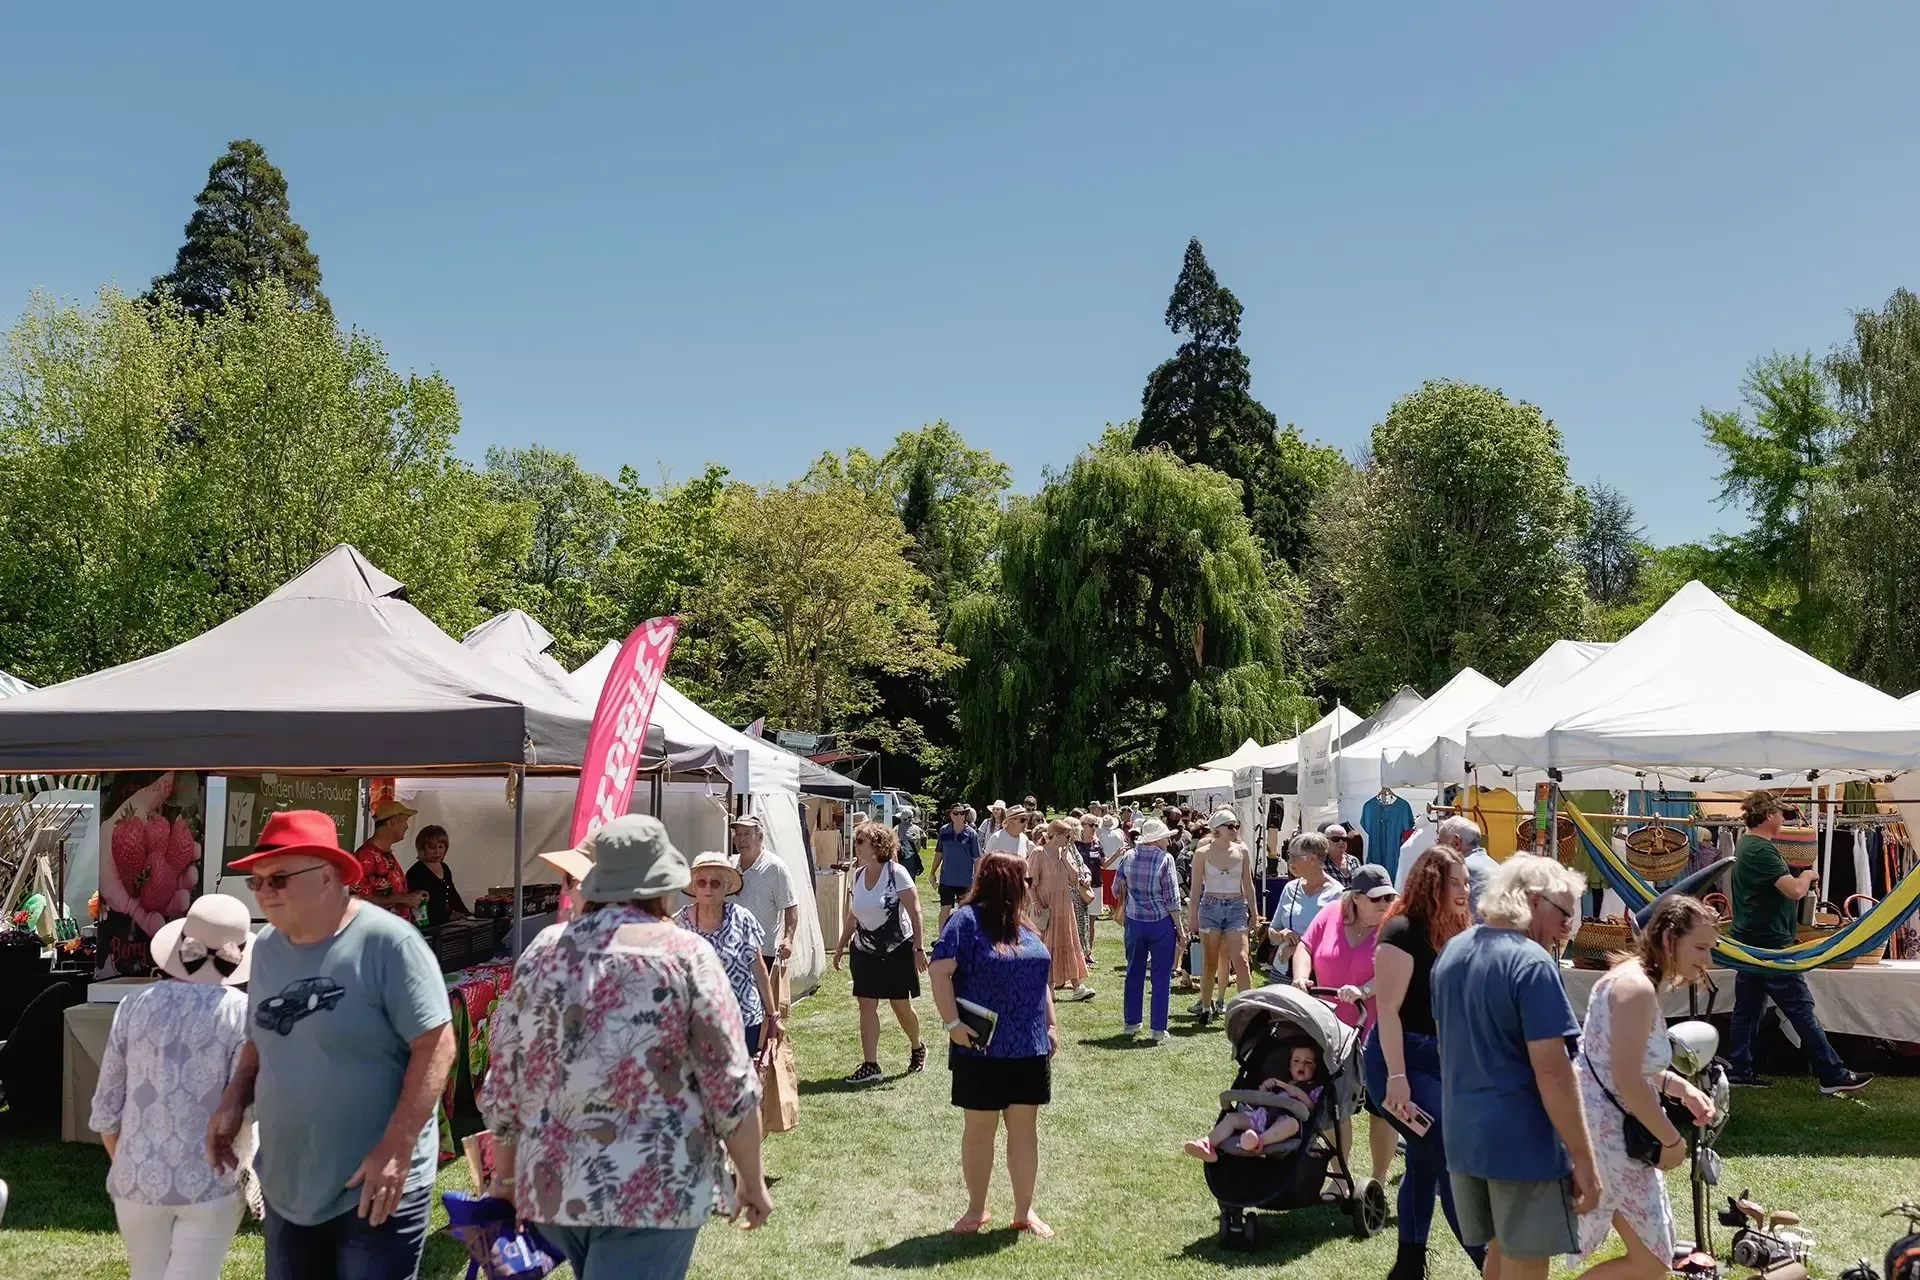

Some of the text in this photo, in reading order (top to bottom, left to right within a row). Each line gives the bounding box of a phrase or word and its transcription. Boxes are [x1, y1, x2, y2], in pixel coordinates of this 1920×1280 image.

[260, 778, 294, 798] Golden
[295, 779, 316, 800] Mile
[317, 782, 352, 802] Produce
[110, 935, 147, 968] Berry
